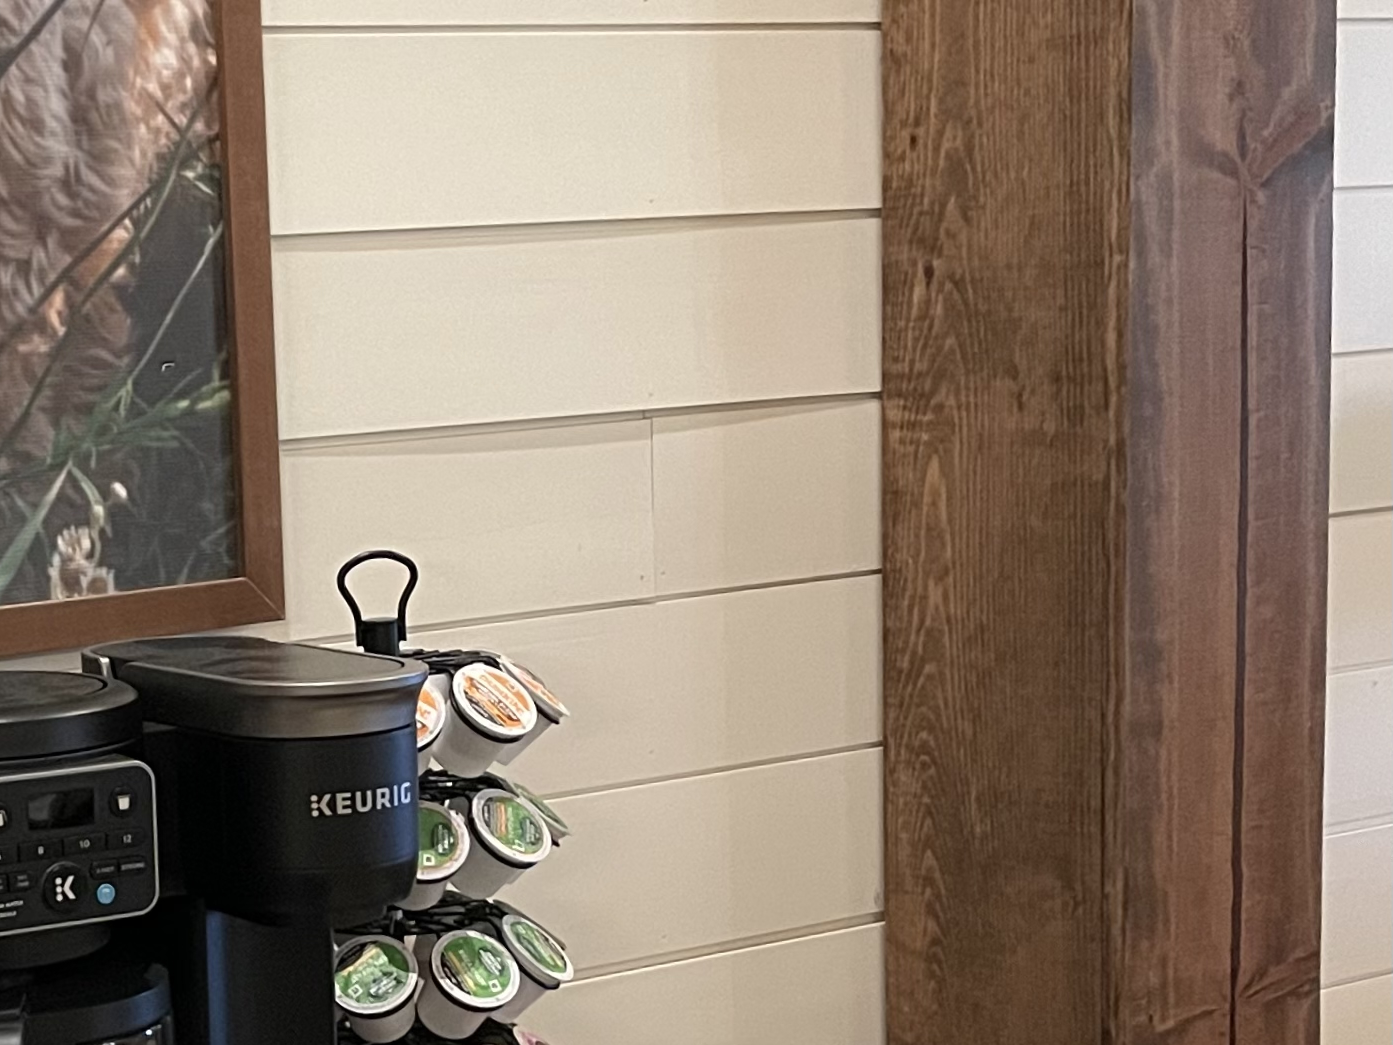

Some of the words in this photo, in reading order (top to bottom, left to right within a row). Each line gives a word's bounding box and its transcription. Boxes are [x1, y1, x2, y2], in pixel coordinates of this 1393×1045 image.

[310, 781, 411, 817] KEURIG
[79, 839, 91, 849] 10
[122, 834, 133, 844] 12
